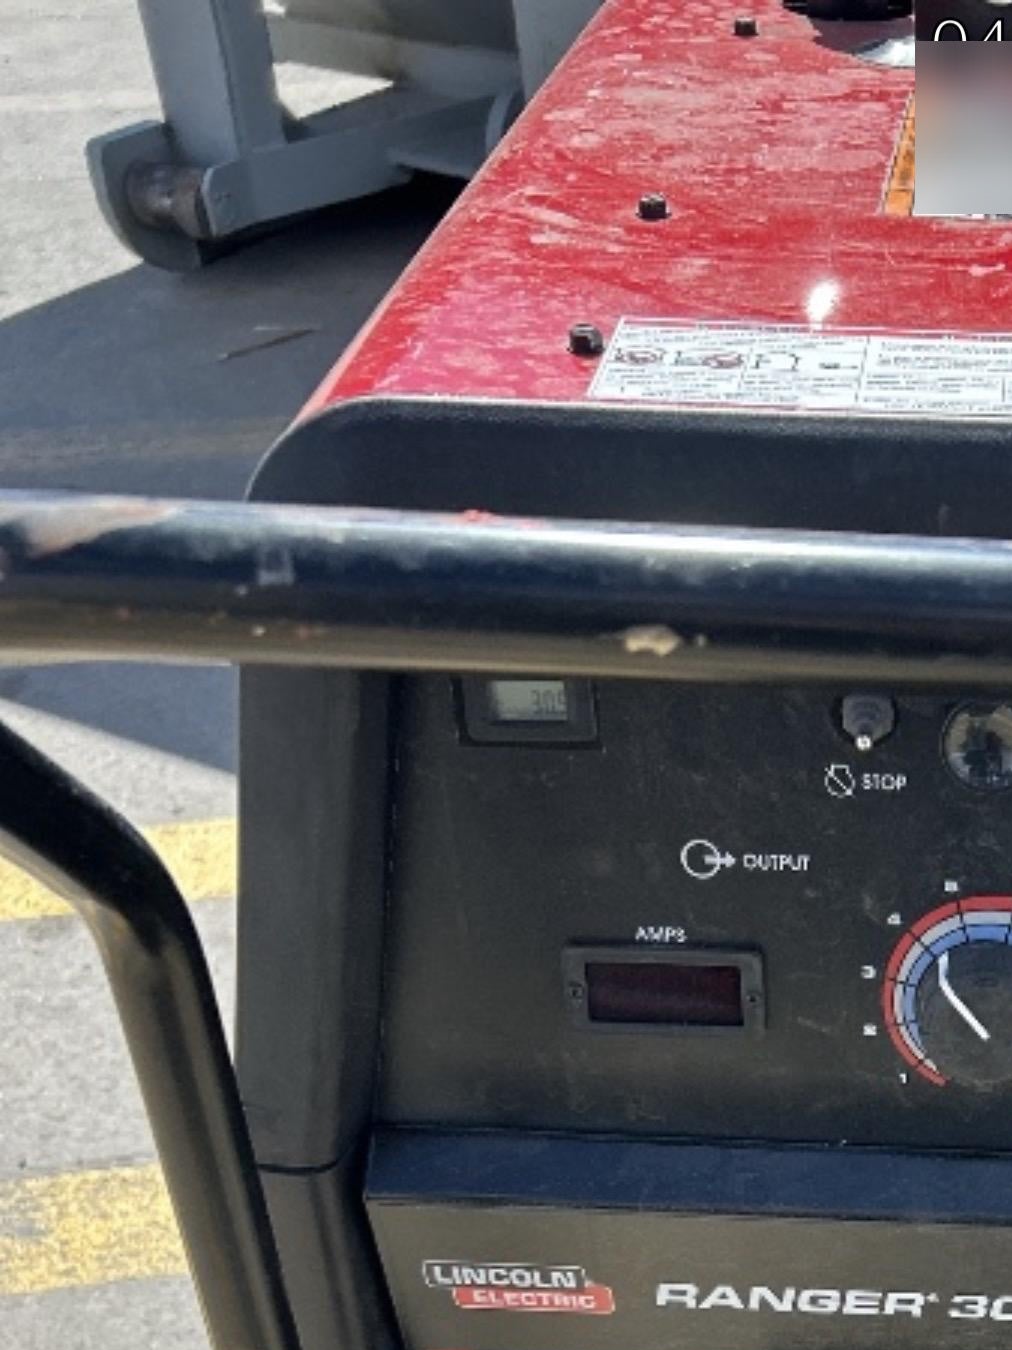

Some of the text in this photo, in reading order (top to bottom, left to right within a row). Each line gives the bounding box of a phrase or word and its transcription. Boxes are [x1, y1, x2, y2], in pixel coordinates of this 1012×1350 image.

[861, 772, 907, 791] STOP
[743, 853, 810, 871] OUTPUT
[635, 926, 687, 943] AMPS
[432, 1265, 577, 1289] LINCOLN
[472, 1289, 597, 1310] ELECTRIC
